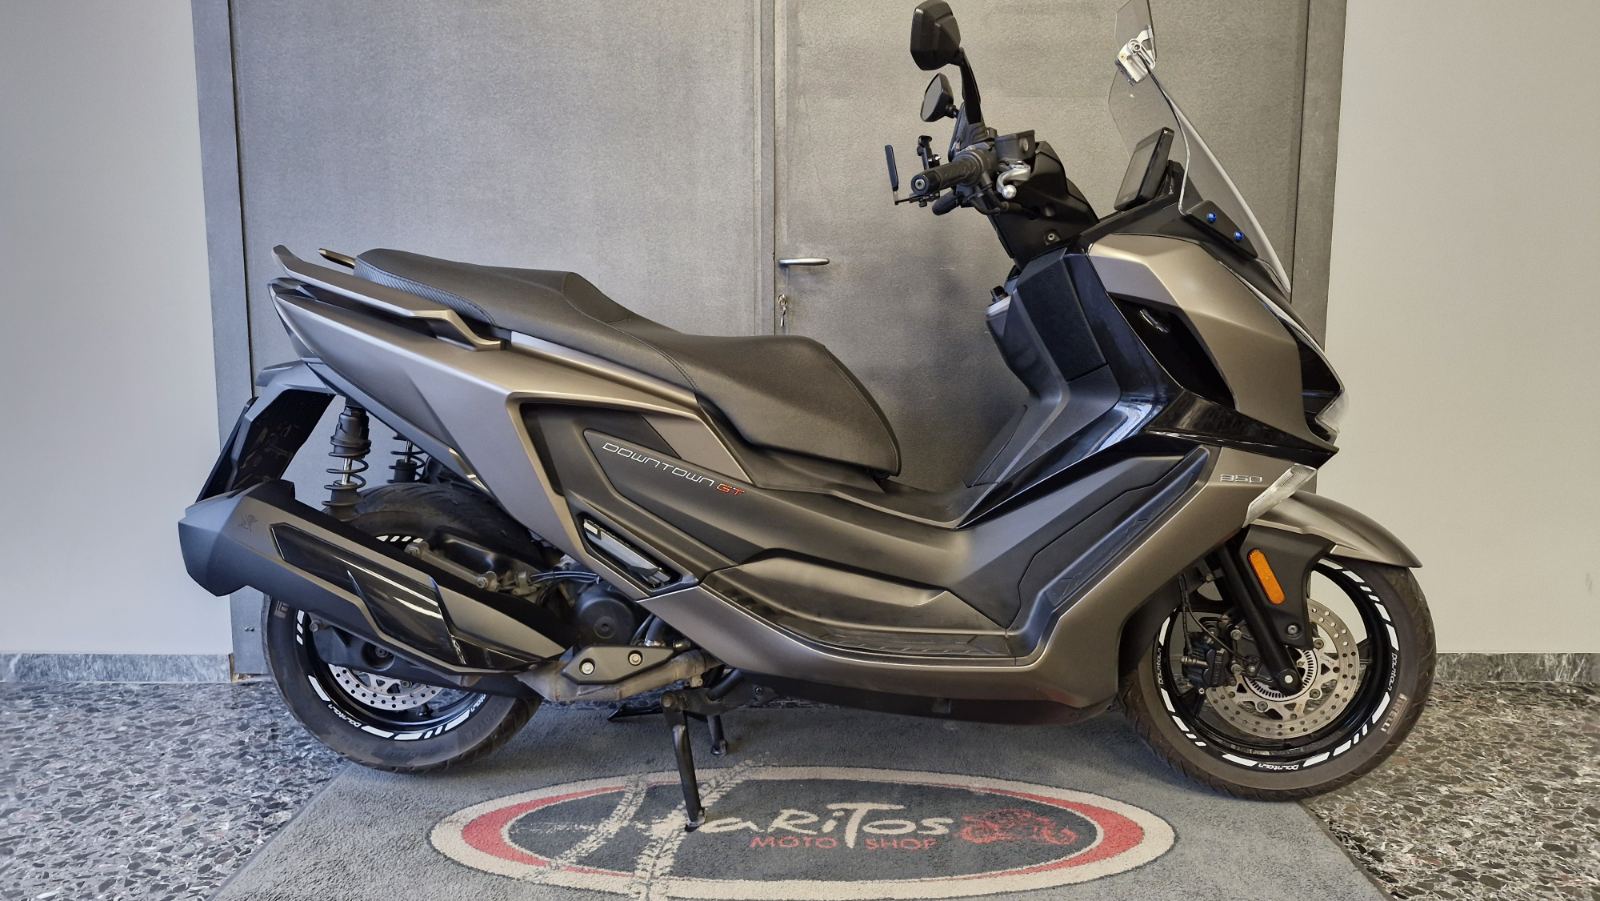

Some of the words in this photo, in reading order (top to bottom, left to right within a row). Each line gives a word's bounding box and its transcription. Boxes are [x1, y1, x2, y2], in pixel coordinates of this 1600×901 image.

[602, 442, 715, 487] DOWNTOWN
[716, 483, 745, 496] GT
[1220, 474, 1263, 484] 350
[750, 836, 838, 849] MOTO
[864, 838, 937, 850] SHOP
